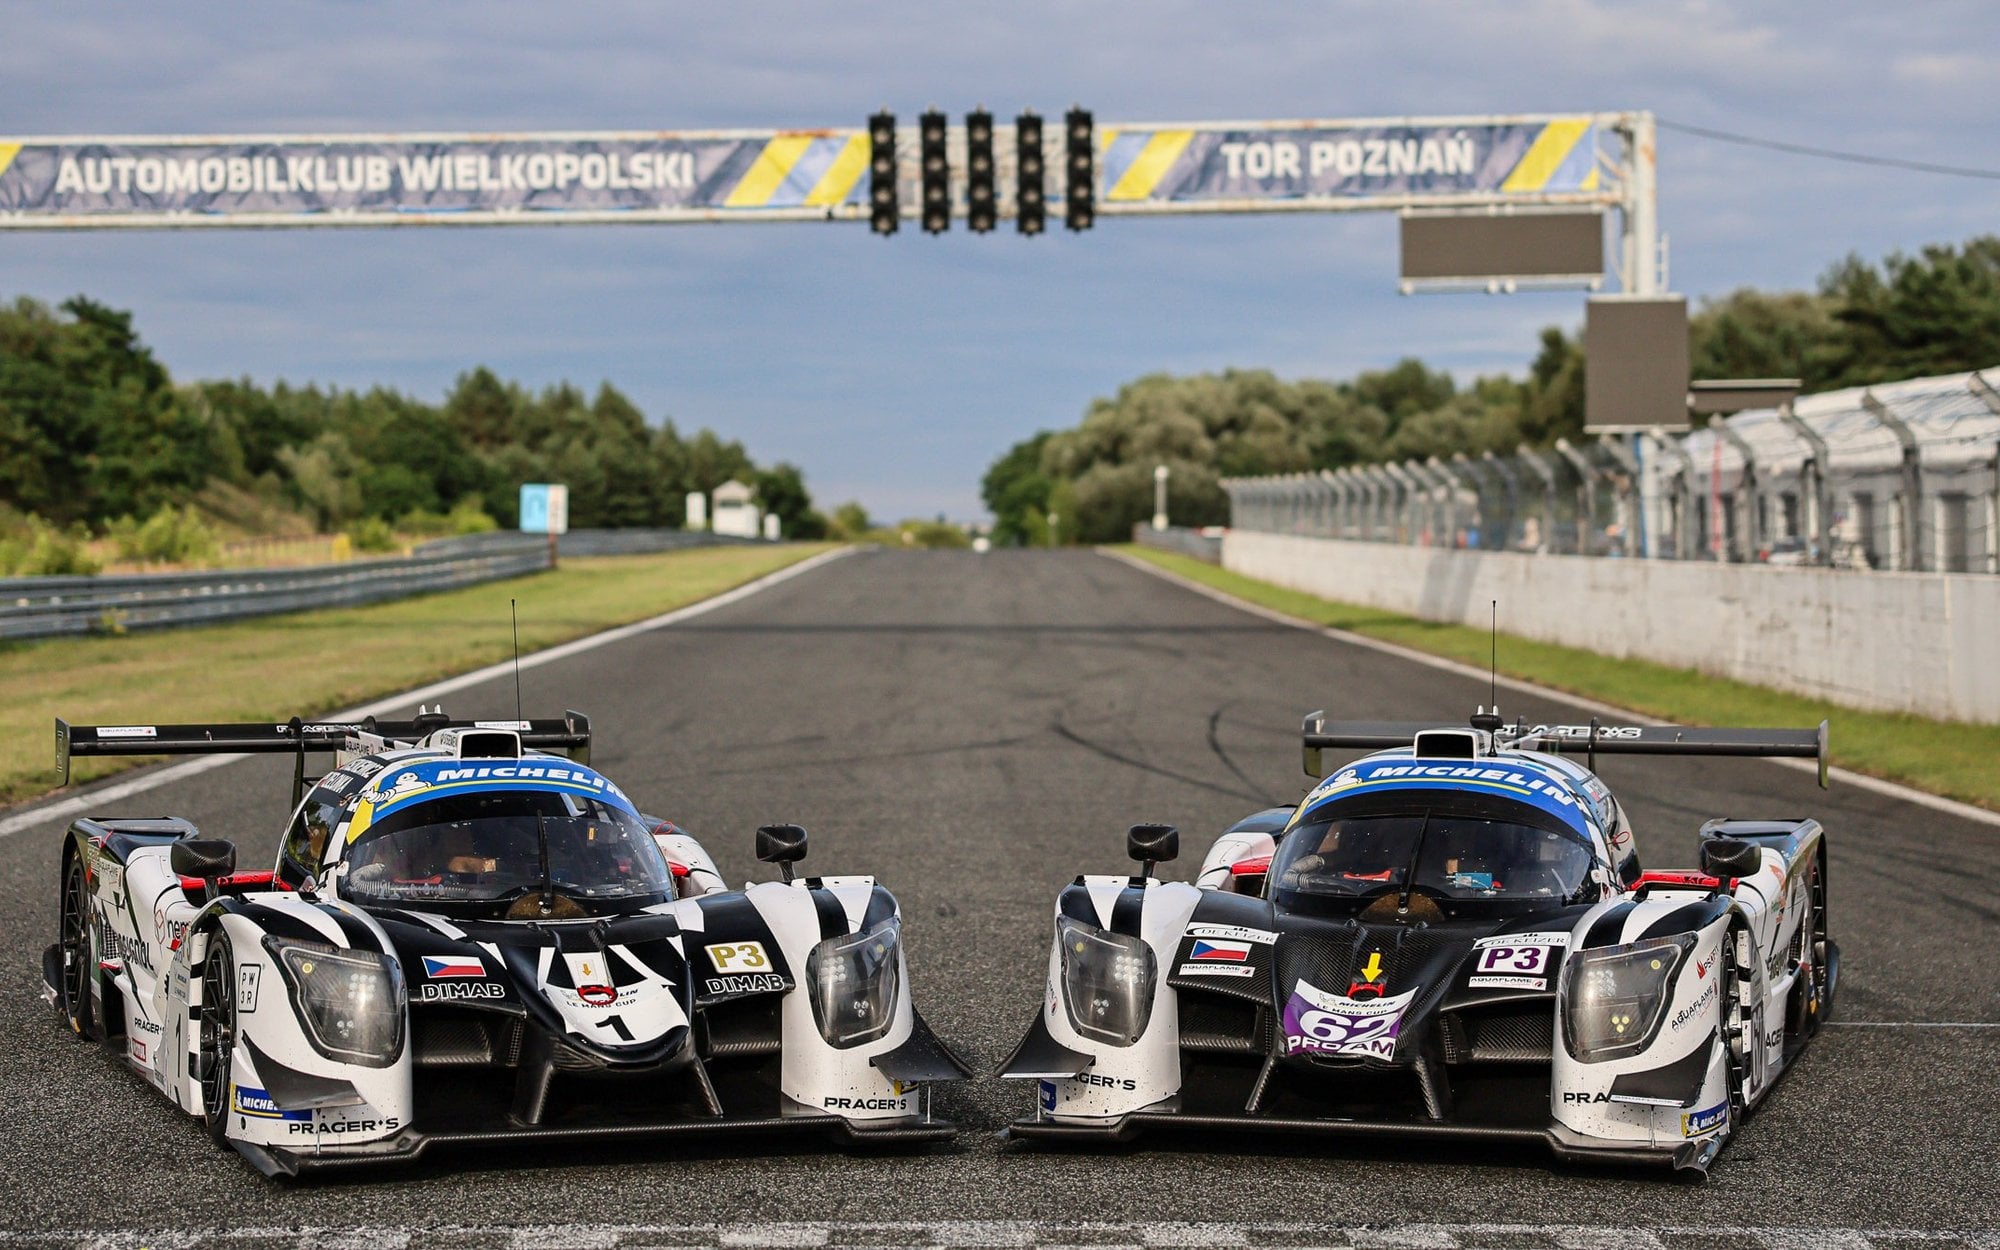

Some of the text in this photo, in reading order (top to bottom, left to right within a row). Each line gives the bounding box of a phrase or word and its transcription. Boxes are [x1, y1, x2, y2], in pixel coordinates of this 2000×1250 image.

[1221, 131, 1475, 179] TOR POZNAŃ
[56, 151, 696, 194] AUTOMOBILKLUB WIELKOPOLSKI
[436, 767, 629, 801] MICHELIN
[1369, 766, 1575, 806] MICHELIN
[711, 944, 765, 968] P3
[1484, 947, 1541, 970] P3
[421, 983, 505, 1002] DIMAB
[706, 974, 784, 994] DIMAB
[615, 998, 637, 1007] CUP
[1339, 1000, 1396, 1008] MICHELIN
[1671, 985, 1713, 1030] AQUAFLAME
[595, 1014, 637, 1041] 1
[1300, 1009, 1400, 1043] 62
[1073, 1071, 1137, 1091] GER'S
[823, 1096, 907, 1110] PRAGER'S
[289, 1117, 399, 1135] PRAGER'S
